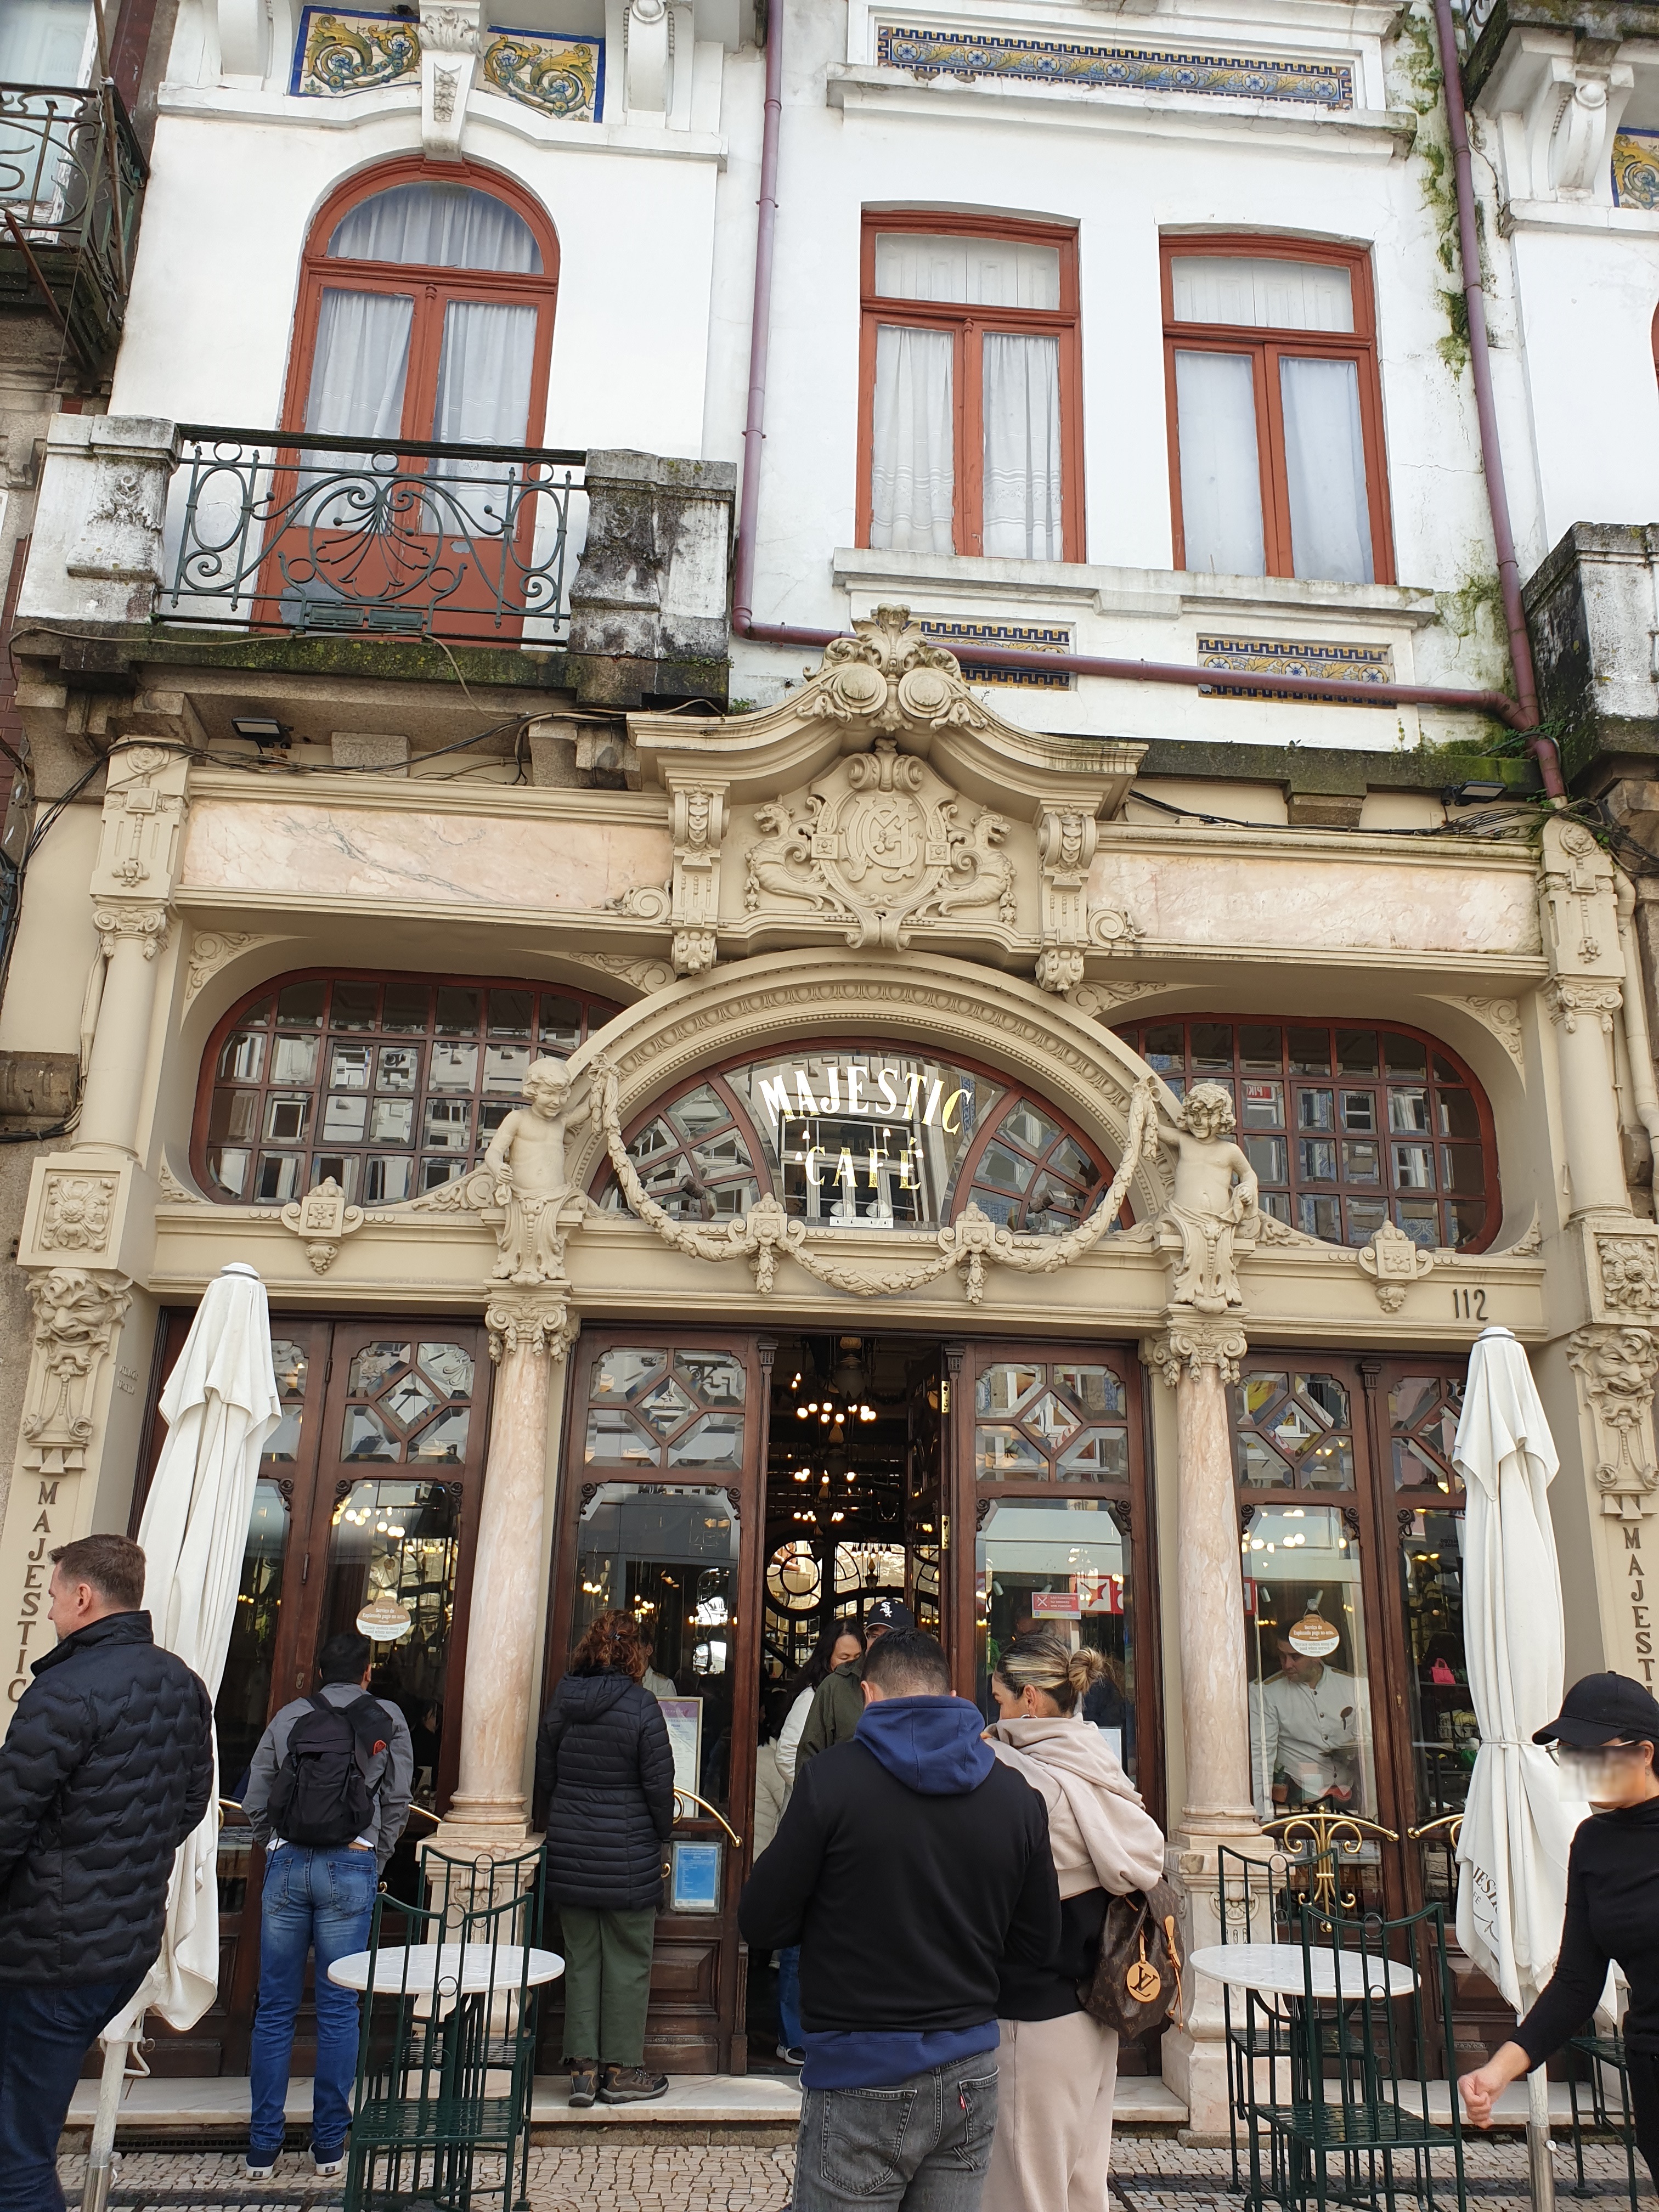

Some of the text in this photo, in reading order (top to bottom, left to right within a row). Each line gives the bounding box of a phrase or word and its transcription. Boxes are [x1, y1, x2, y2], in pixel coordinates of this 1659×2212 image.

[758, 1065, 973, 1136] MAJESTIC
[805, 1136, 921, 1189] CAFÉ
[1453, 1289, 1488, 1321] 112
[8, 1481, 60, 1702] MAJESTIC
[1622, 1527, 1655, 1697] MAJEST
